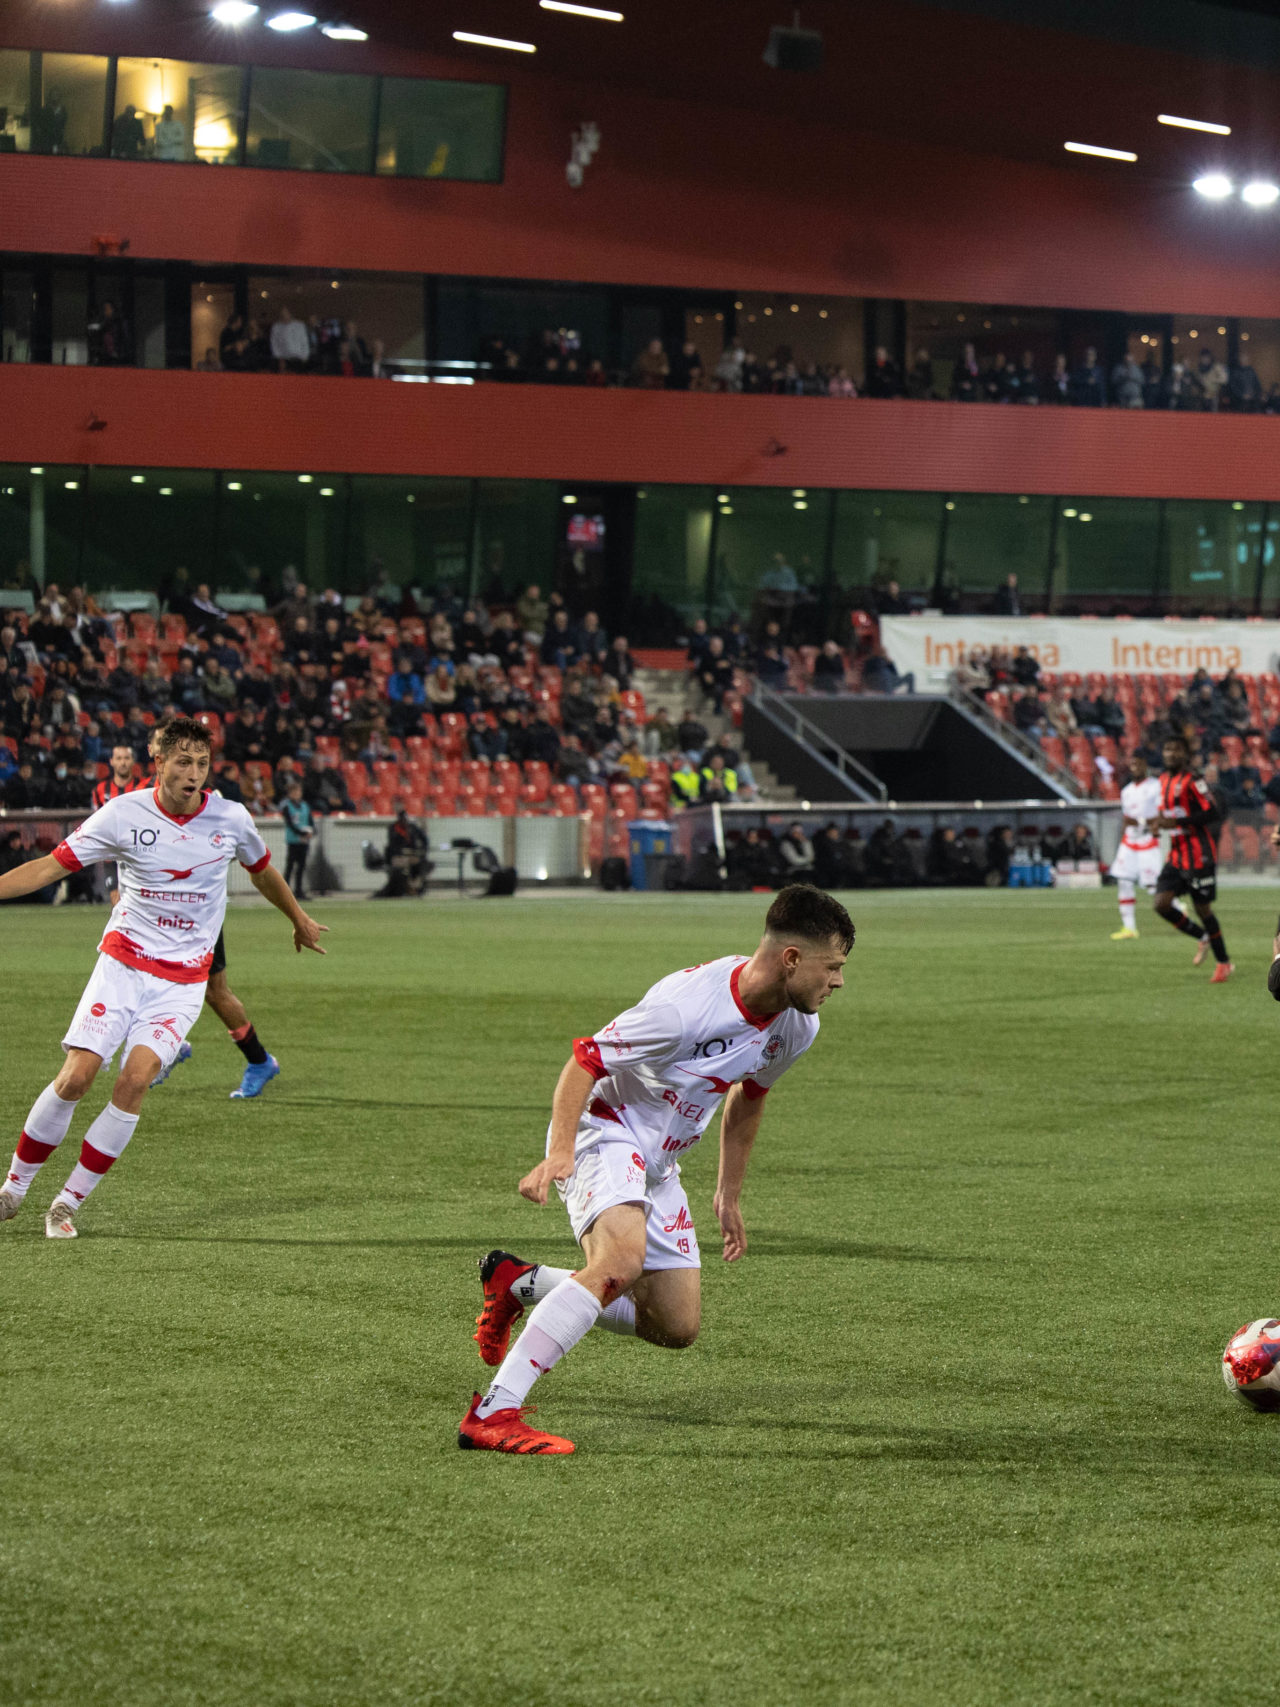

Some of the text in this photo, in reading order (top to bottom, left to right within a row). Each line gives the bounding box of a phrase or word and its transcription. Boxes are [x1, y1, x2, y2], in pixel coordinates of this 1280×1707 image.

[1112, 637, 1242, 669] Interima
[153, 891, 207, 903] KELLER
[152, 1029, 164, 1040] 16
[677, 1238, 690, 1253] 19
